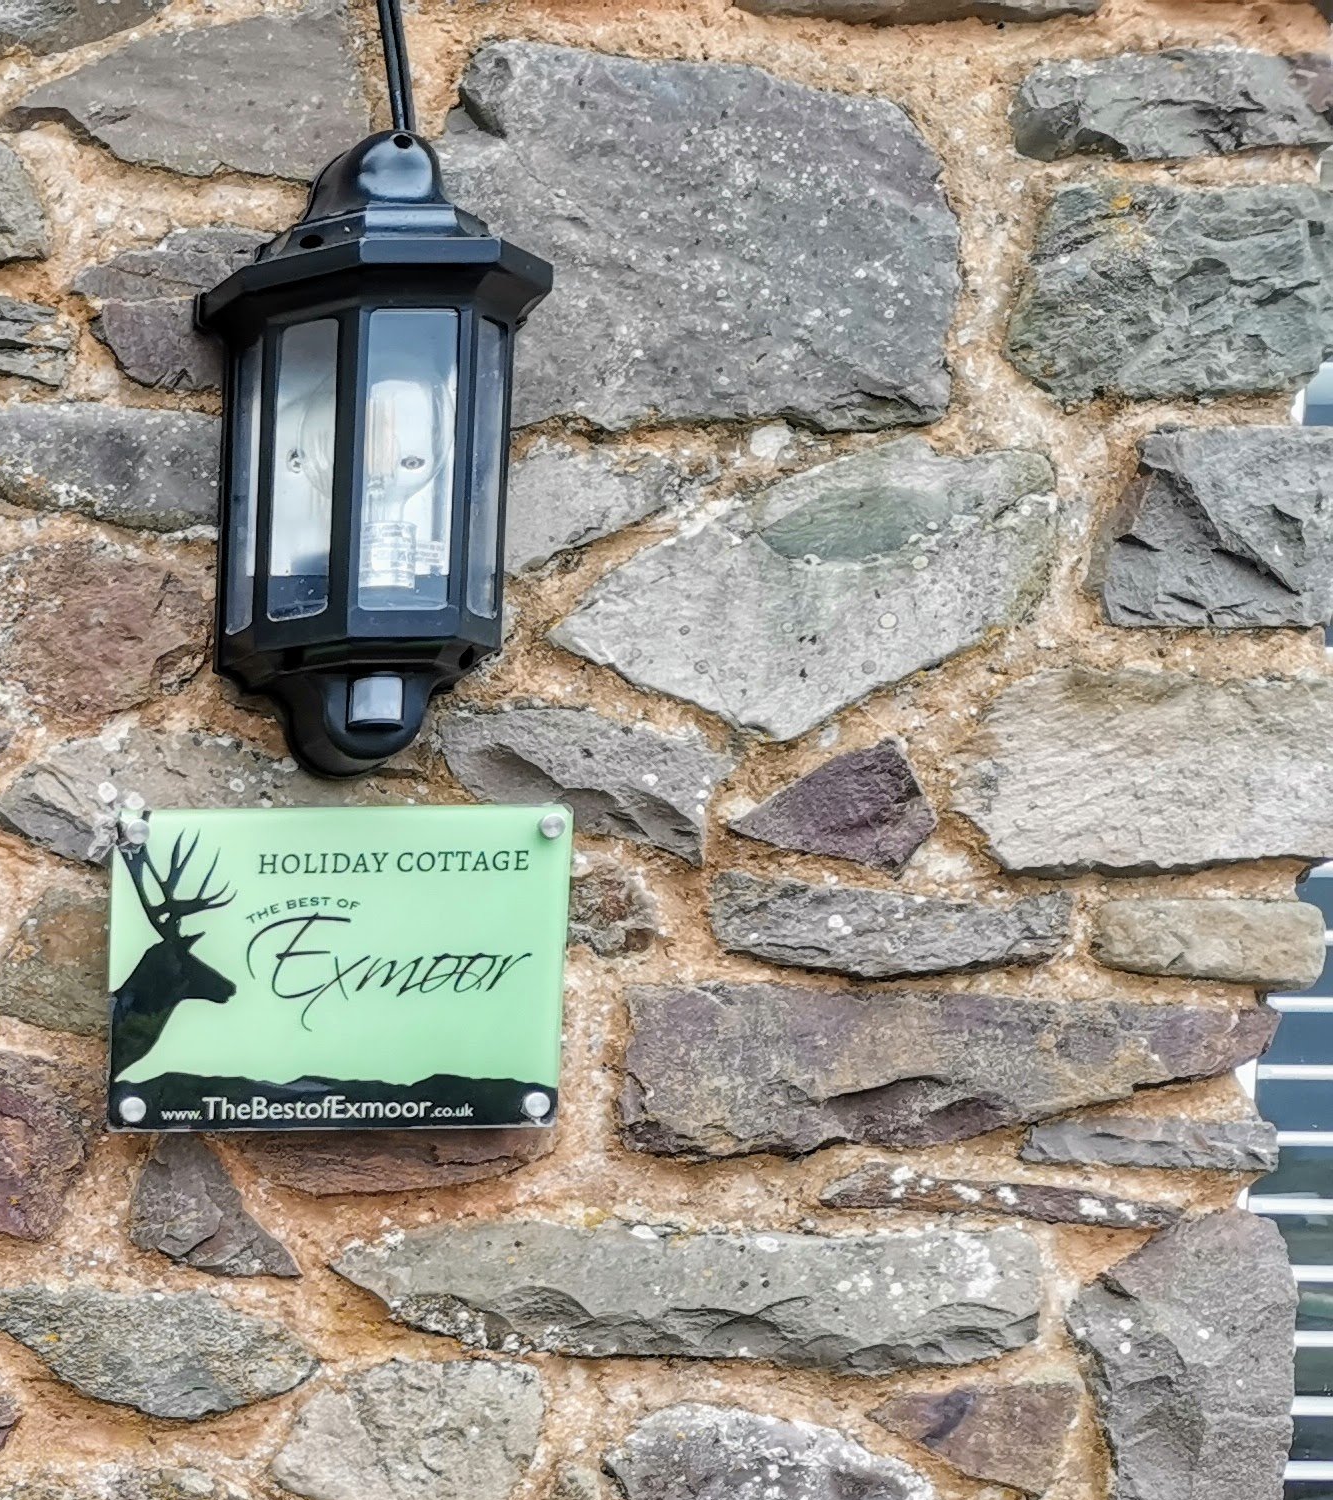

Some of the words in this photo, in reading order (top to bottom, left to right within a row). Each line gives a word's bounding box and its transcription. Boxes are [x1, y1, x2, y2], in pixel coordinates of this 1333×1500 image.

[258, 852, 389, 875] HOLIDAY
[397, 849, 531, 873] COTTAGE
[246, 903, 282, 924] THE
[285, 896, 331, 910] BEST
[336, 897, 362, 911] OF
[246, 912, 532, 1032] Exmoor
[161, 1096, 474, 1121] www.TheBestofExmoor.co.uk
